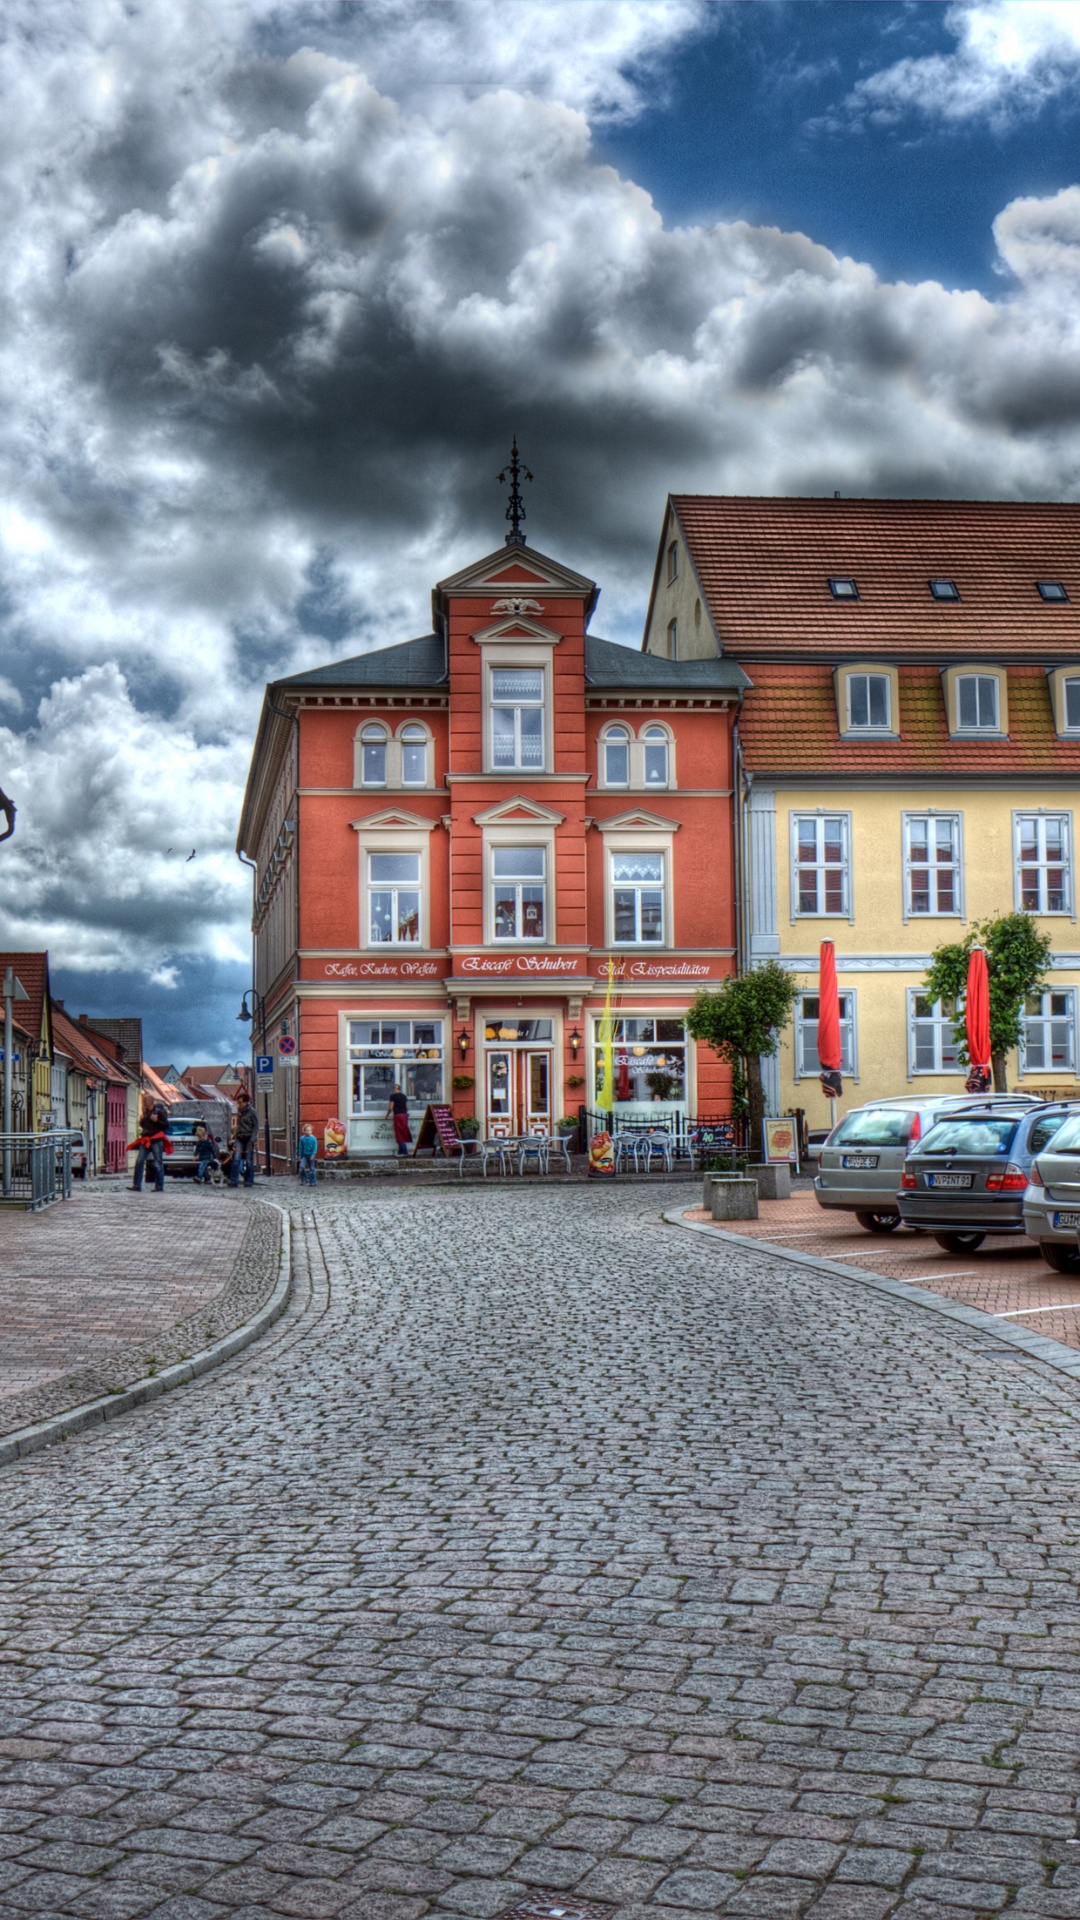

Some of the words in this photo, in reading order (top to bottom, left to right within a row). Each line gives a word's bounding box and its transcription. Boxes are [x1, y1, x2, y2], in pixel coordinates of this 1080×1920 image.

[324, 963, 358, 977] Kaffee,
[360, 963, 398, 976] Kuchen,
[400, 962, 438, 977] Waffeln
[461, 957, 515, 974] Eiscafé
[516, 956, 578, 971] Schubert
[630, 962, 710, 977] Eisspezialitäten
[259, 1058, 270, 1071] P
[702, 1132, 714, 1142] 40
